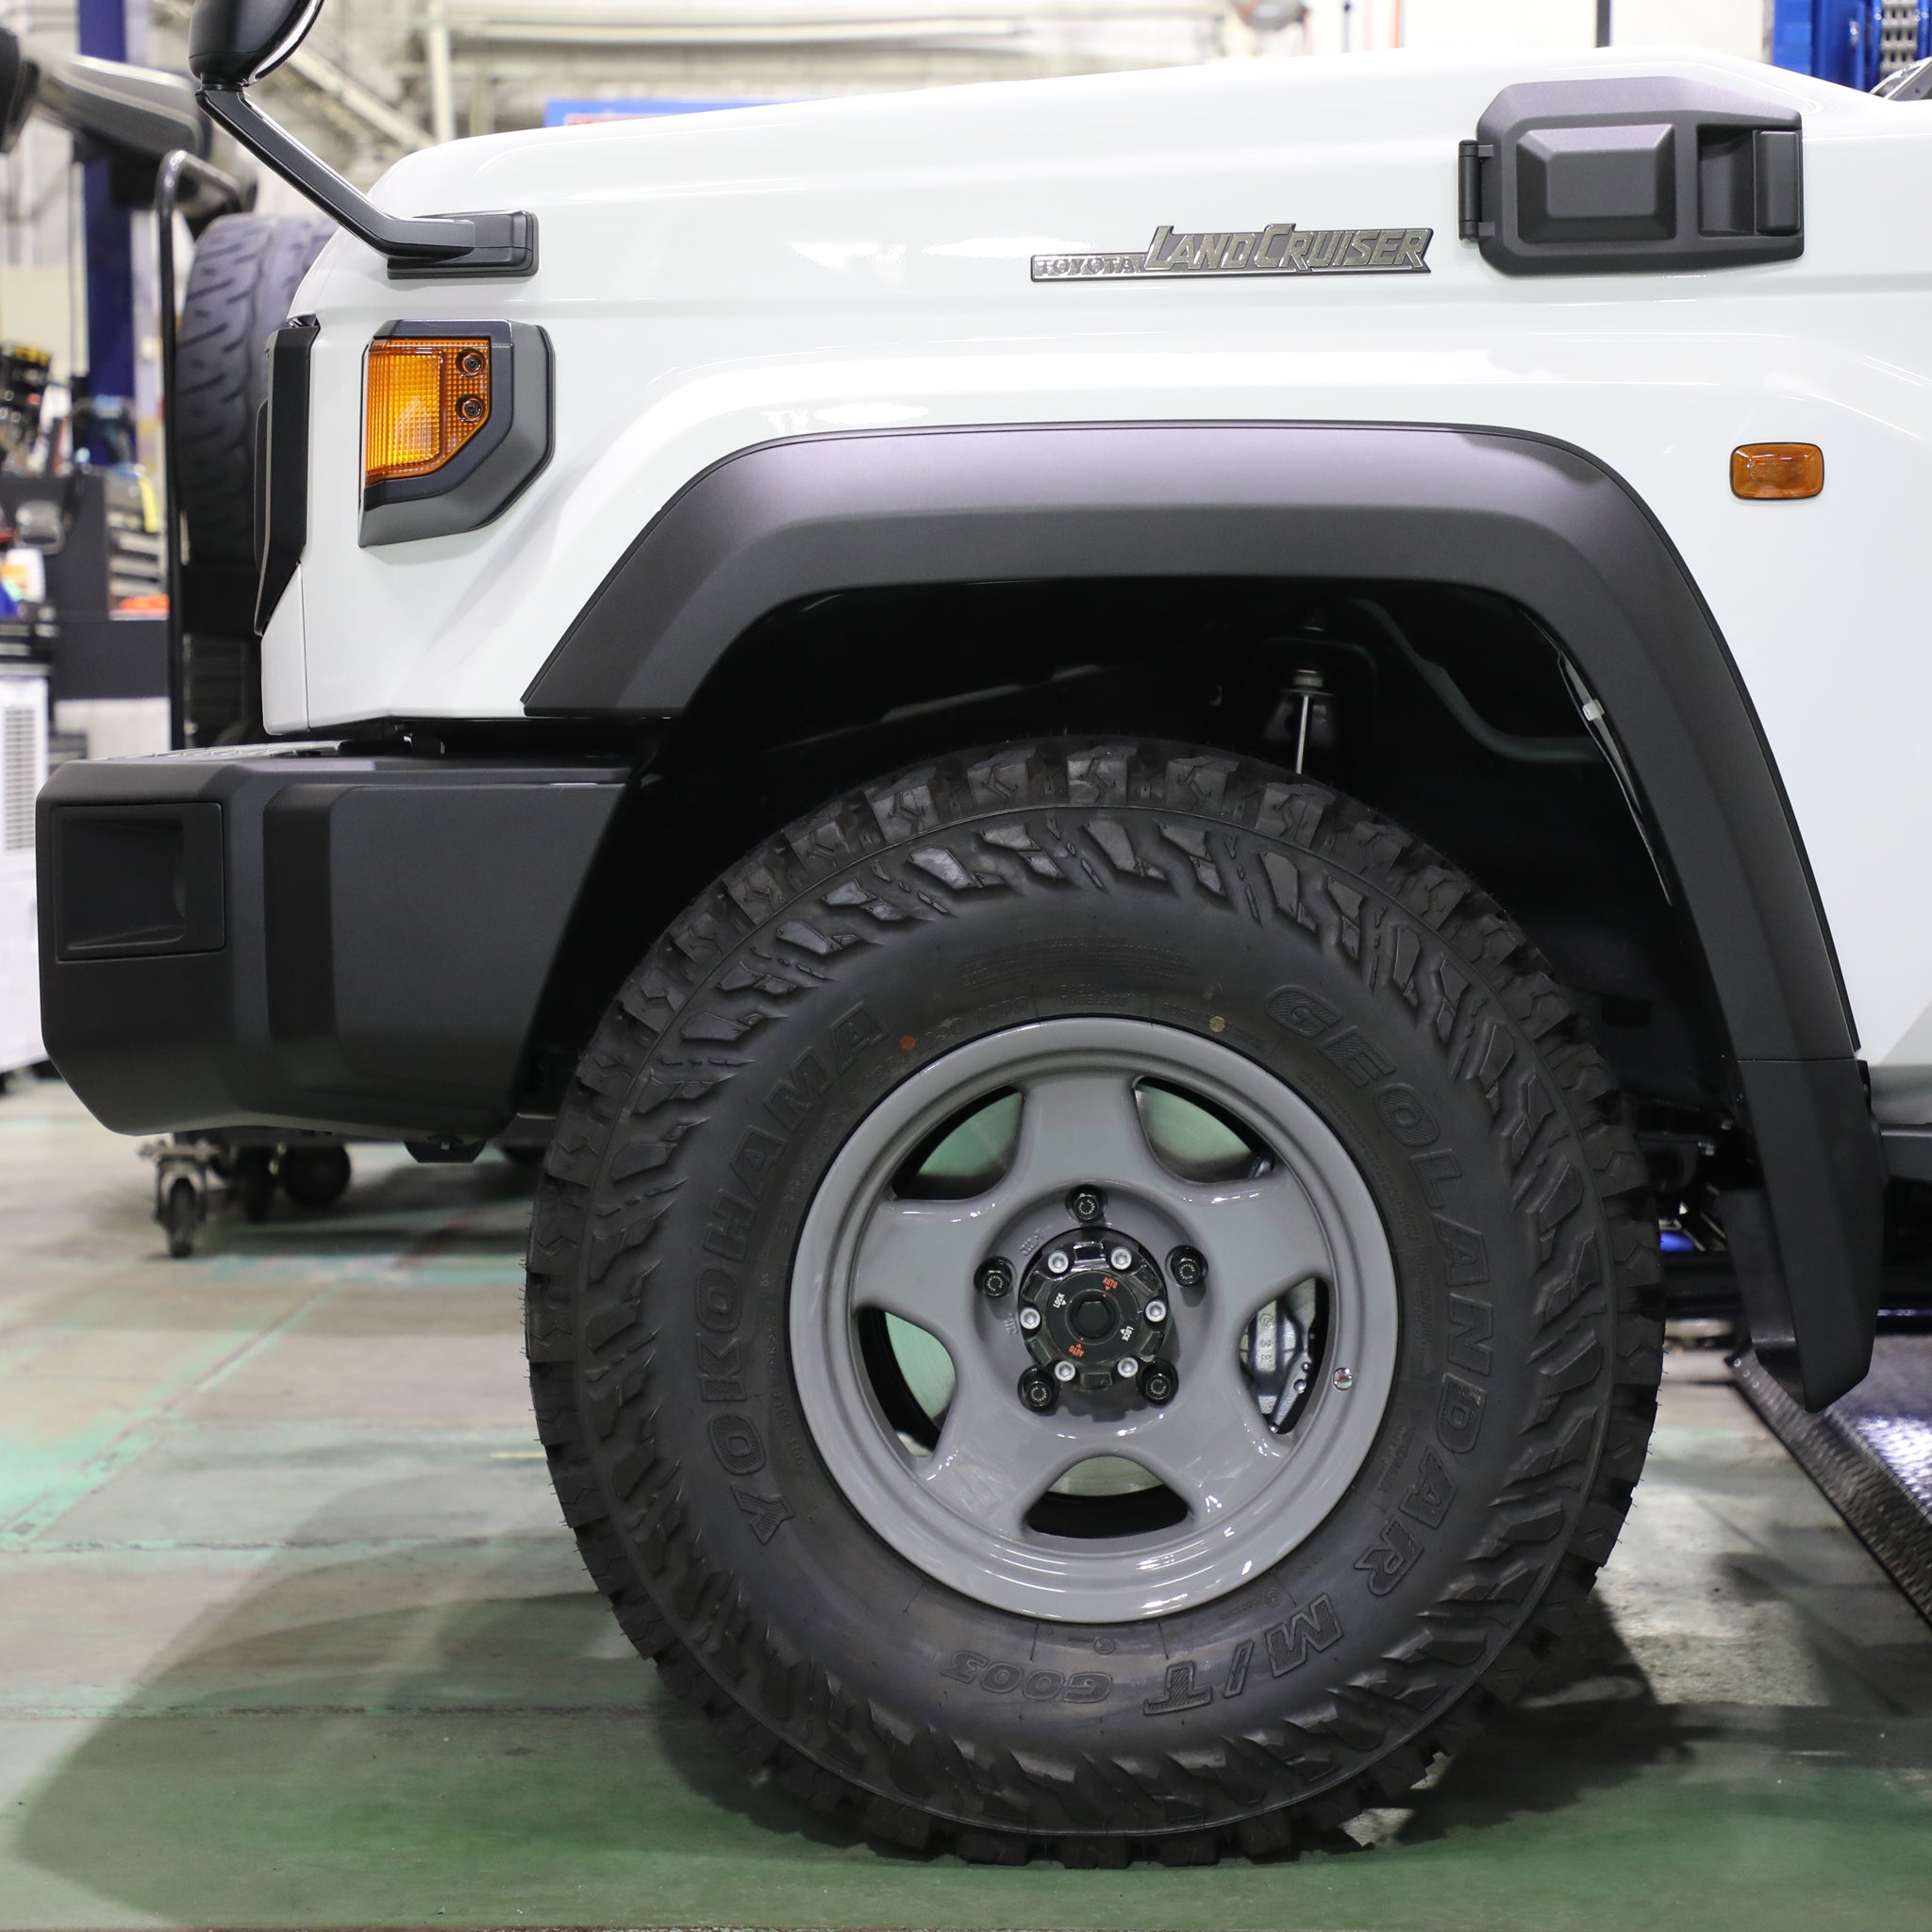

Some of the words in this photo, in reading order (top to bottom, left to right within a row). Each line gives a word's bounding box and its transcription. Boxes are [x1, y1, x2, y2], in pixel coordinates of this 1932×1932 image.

[1036, 256, 1135, 276] TOYOTA
[694, 1001, 887, 1545] YOKOHAMA
[1103, 1276, 1118, 1289] AUTO
[1264, 984, 1493, 1595] GEOLANDAR
[1053, 1292, 1065, 1308] LOCK
[1122, 1325, 1134, 1341] LOCK
[1069, 1345, 1085, 1357] AUTO
[1144, 1593, 1343, 1716] M/T
[940, 1651, 1113, 1704] G003
